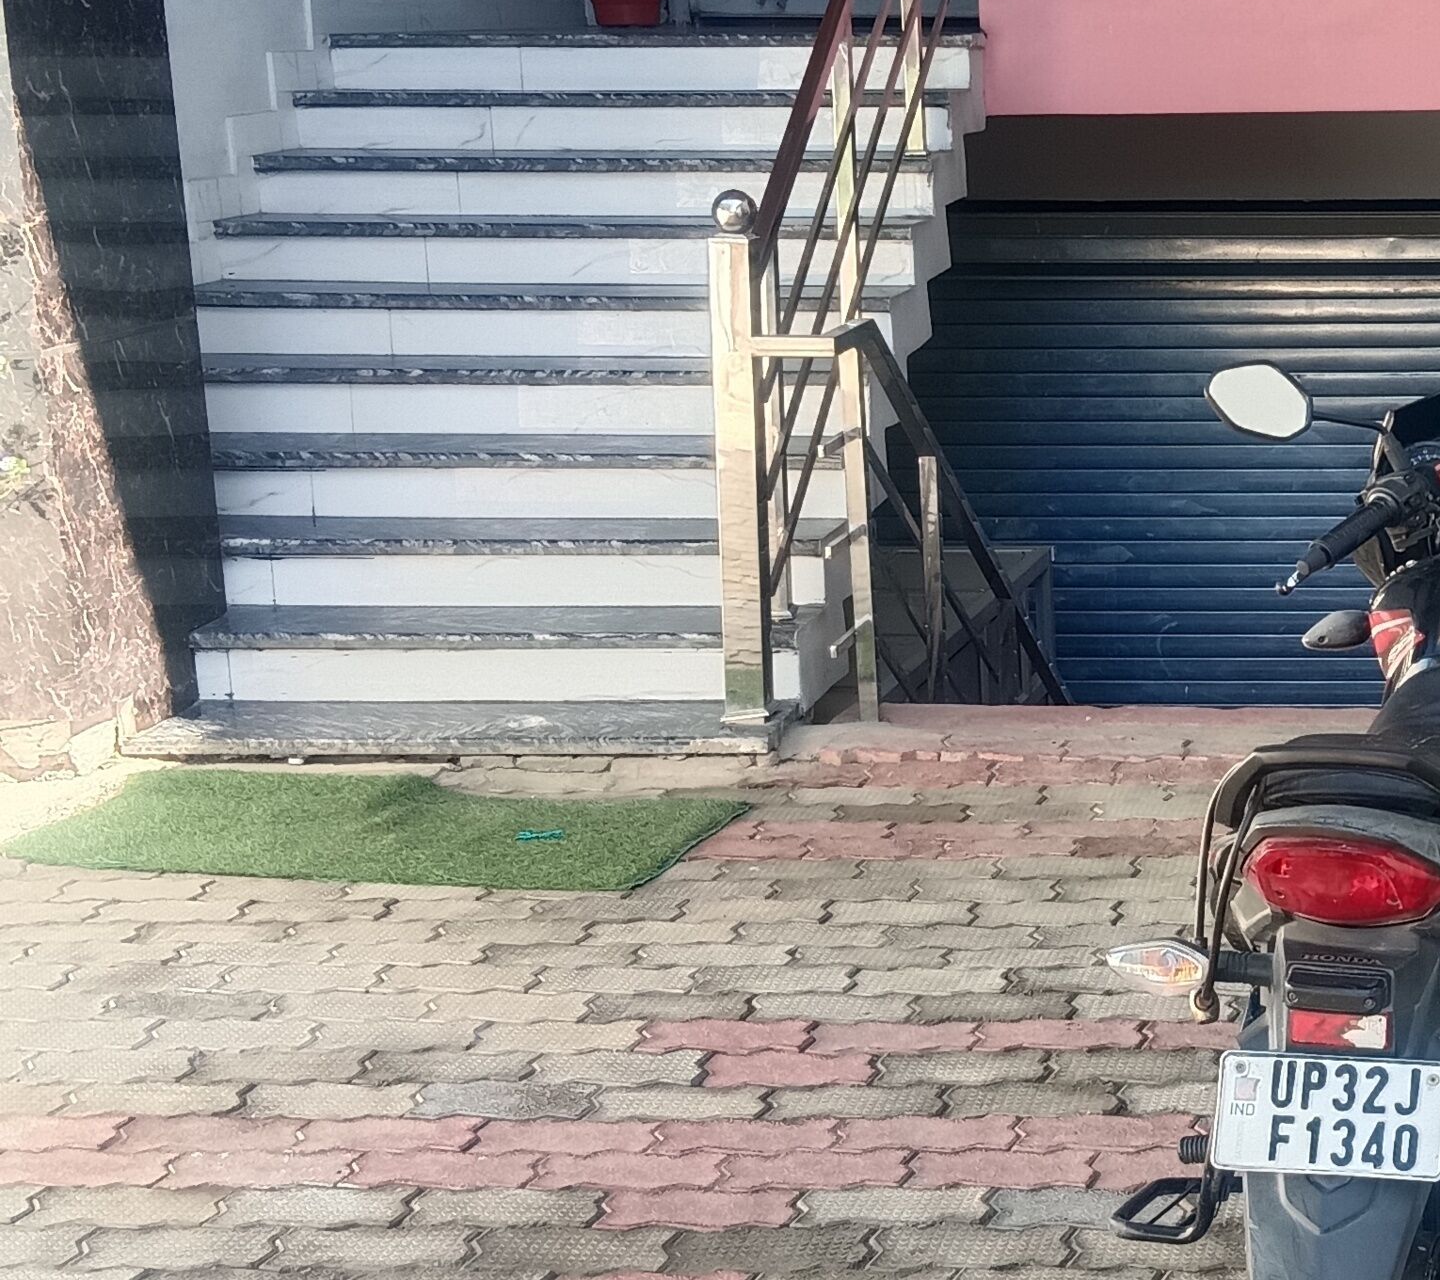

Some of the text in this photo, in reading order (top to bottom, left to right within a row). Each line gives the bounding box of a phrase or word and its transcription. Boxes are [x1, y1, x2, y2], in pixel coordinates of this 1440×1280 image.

[1301, 953, 1384, 966] HONDA
[1271, 1060, 1421, 1116] UP32J
[1230, 1103, 1255, 1116] IND
[1268, 1115, 1418, 1171] F1340
